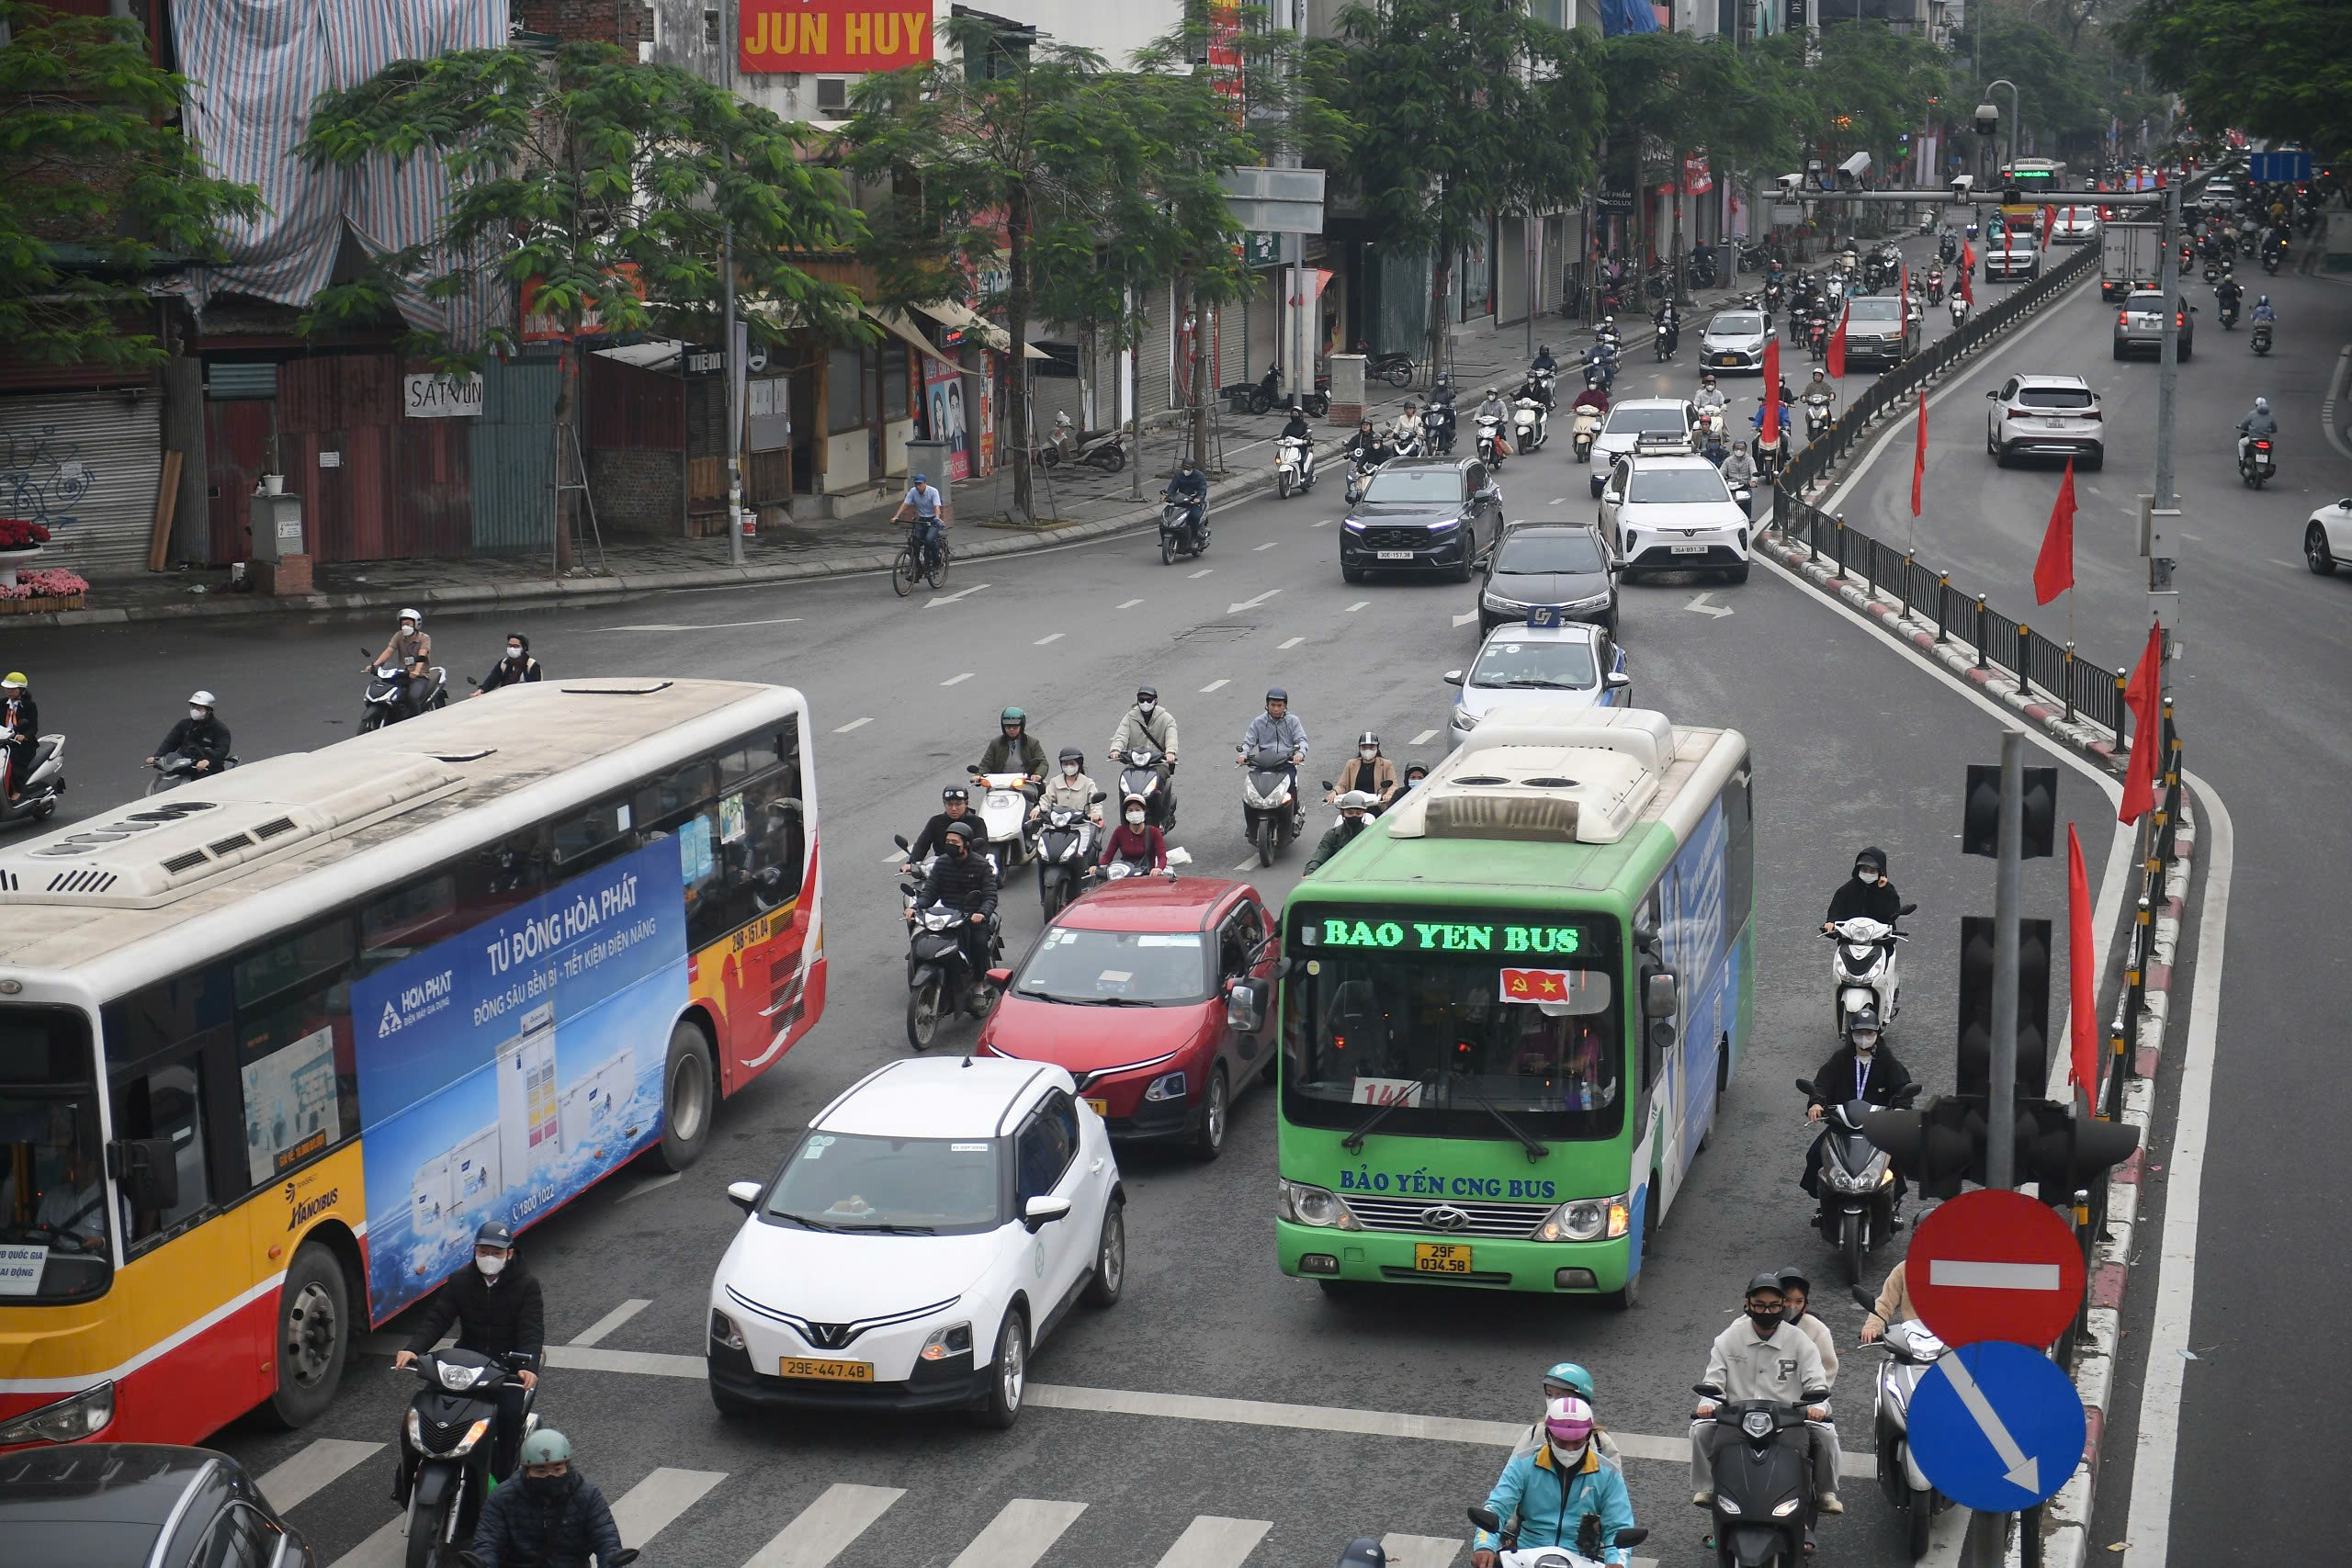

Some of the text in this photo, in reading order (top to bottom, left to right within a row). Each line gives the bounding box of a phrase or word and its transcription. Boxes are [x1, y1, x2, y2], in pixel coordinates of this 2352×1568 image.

[745, 12, 927, 55] JUN HUY
[447, 382, 481, 407] VỤN
[487, 872, 638, 976] TỦ ĐÔNG HÒA PHÁT
[1323, 919, 1578, 953] BAO YEN BUS
[425, 970, 452, 1001] PHAT
[473, 995, 504, 1027] ĐÔNG
[506, 983, 526, 1010] SÂU
[527, 969, 547, 999] BỀN
[548, 961, 557, 987] BỈ
[564, 948, 582, 978] TIẾT
[584, 942, 606, 969] KIỆM
[608, 931, 629, 956] ĐIỆN
[630, 918, 656, 944] NĂNG
[1340, 1163, 1555, 1199] BẢO YẾN CNG BUS
[287, 1188, 338, 1232] HANOIBUS
[519, 1183, 554, 1216] 1800 1022
[7, 1248, 28, 1259] QUỐC
[29, 1251, 43, 1259] GIA
[1421, 1258, 1464, 1271] 034.58
[1430, 1246, 1455, 1258] 29F
[0, 1268, 8, 1276] AI
[787, 1361, 865, 1378] 29E-447.48
[1778, 1359, 1798, 1381] P
